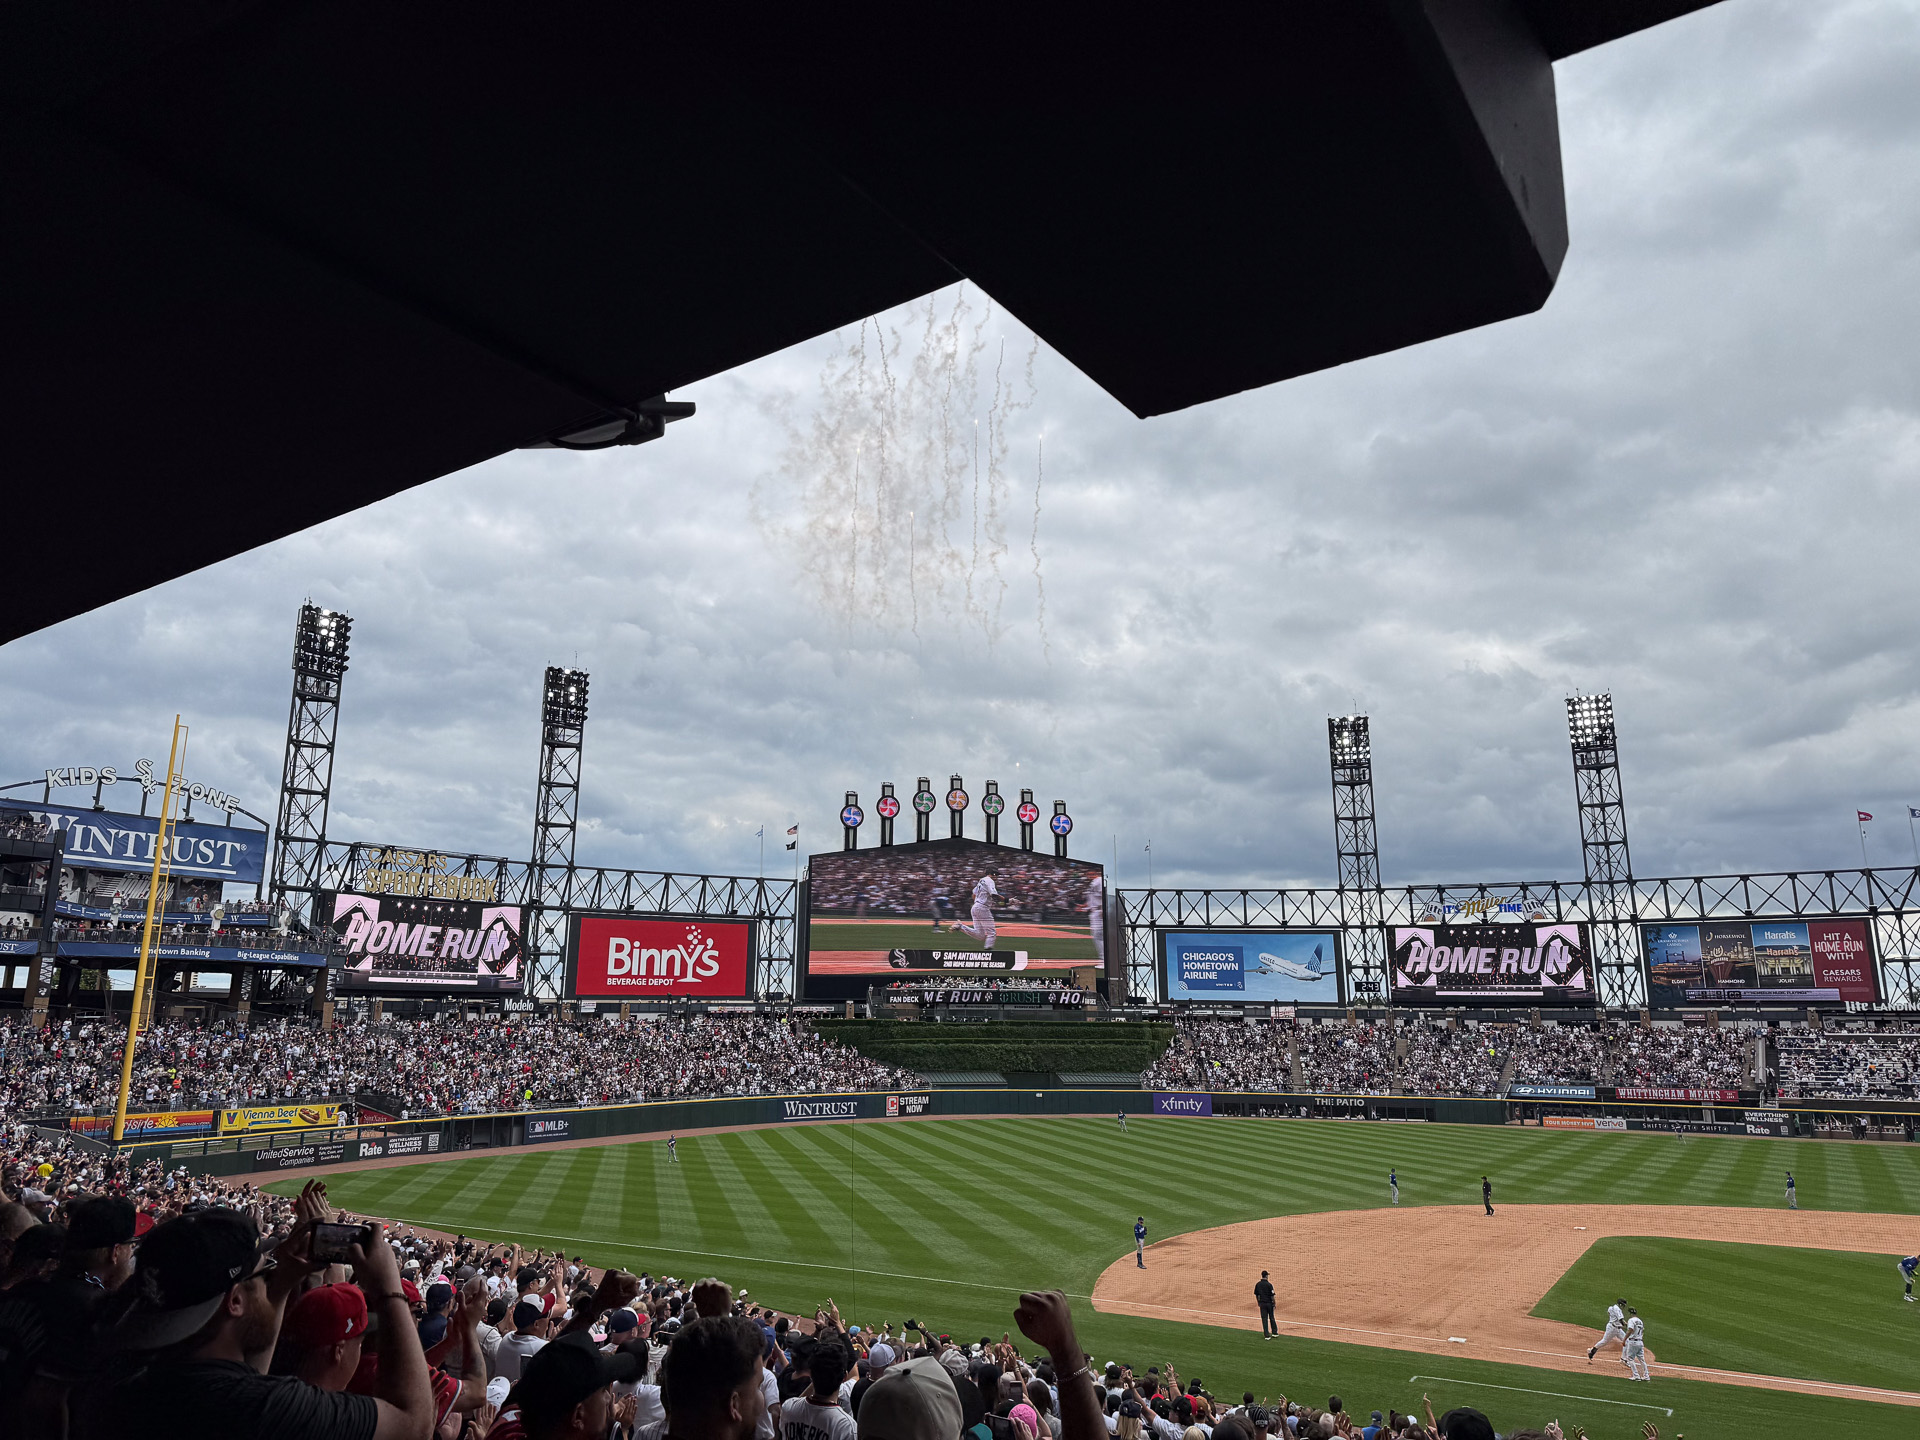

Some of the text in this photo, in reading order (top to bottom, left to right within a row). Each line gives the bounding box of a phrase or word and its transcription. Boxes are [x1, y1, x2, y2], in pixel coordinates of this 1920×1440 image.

[46, 767, 117, 788] KIDS
[171, 775, 240, 815] ZONE
[368, 847, 448, 870] CAESARS
[365, 868, 499, 902] SPORTSBOOK
[1425, 896, 1541, 918] Lite IT'S Miller TIME Lite
[347, 919, 509, 962] HOME RUN
[1764, 931, 1796, 940] Harrah's
[1823, 932, 1852, 941] HIT A
[1814, 940, 1864, 953] HOME RUN
[133, 947, 211, 958] Hmetown Banking
[237, 951, 300, 961] Big-League Capabilities
[943, 952, 992, 960] SAM ANTONACCI
[1182, 952, 1235, 961] CHICAGO'S
[1826, 952, 1854, 961] WITH
[1405, 945, 1569, 975] HOME RUN
[1183, 962, 1239, 971] HOMETOWN
[1183, 971, 1218, 980] AIRLINE
[607, 978, 674, 986] BEVERAGE DEPOT
[1361, 983, 1380, 991] 2:43
[950, 991, 982, 1003] RUN
[1010, 992, 1041, 1003] RUSH
[503, 998, 534, 1011] Modelo
[1844, 1000, 1868, 1014] Lite
[1617, 1088, 1721, 1101] WHITTINGHAM MEATS
[900, 1096, 929, 1105] STREAM
[1161, 1097, 1203, 1112] xfinity
[1315, 1098, 1365, 1107] THE PATIO
[243, 1107, 298, 1120] Vienna Beef
[784, 1100, 858, 1116] WINTRUST
[906, 1105, 923, 1113] NOW
[545, 1120, 569, 1131] MLB+
[1746, 1124, 1770, 1134] Rate
[359, 1142, 383, 1157] Rate
[388, 1140, 422, 1149] WELLNESS
[387, 1146, 422, 1155] COMMUNITY
[279, 1156, 315, 1167] Companies
